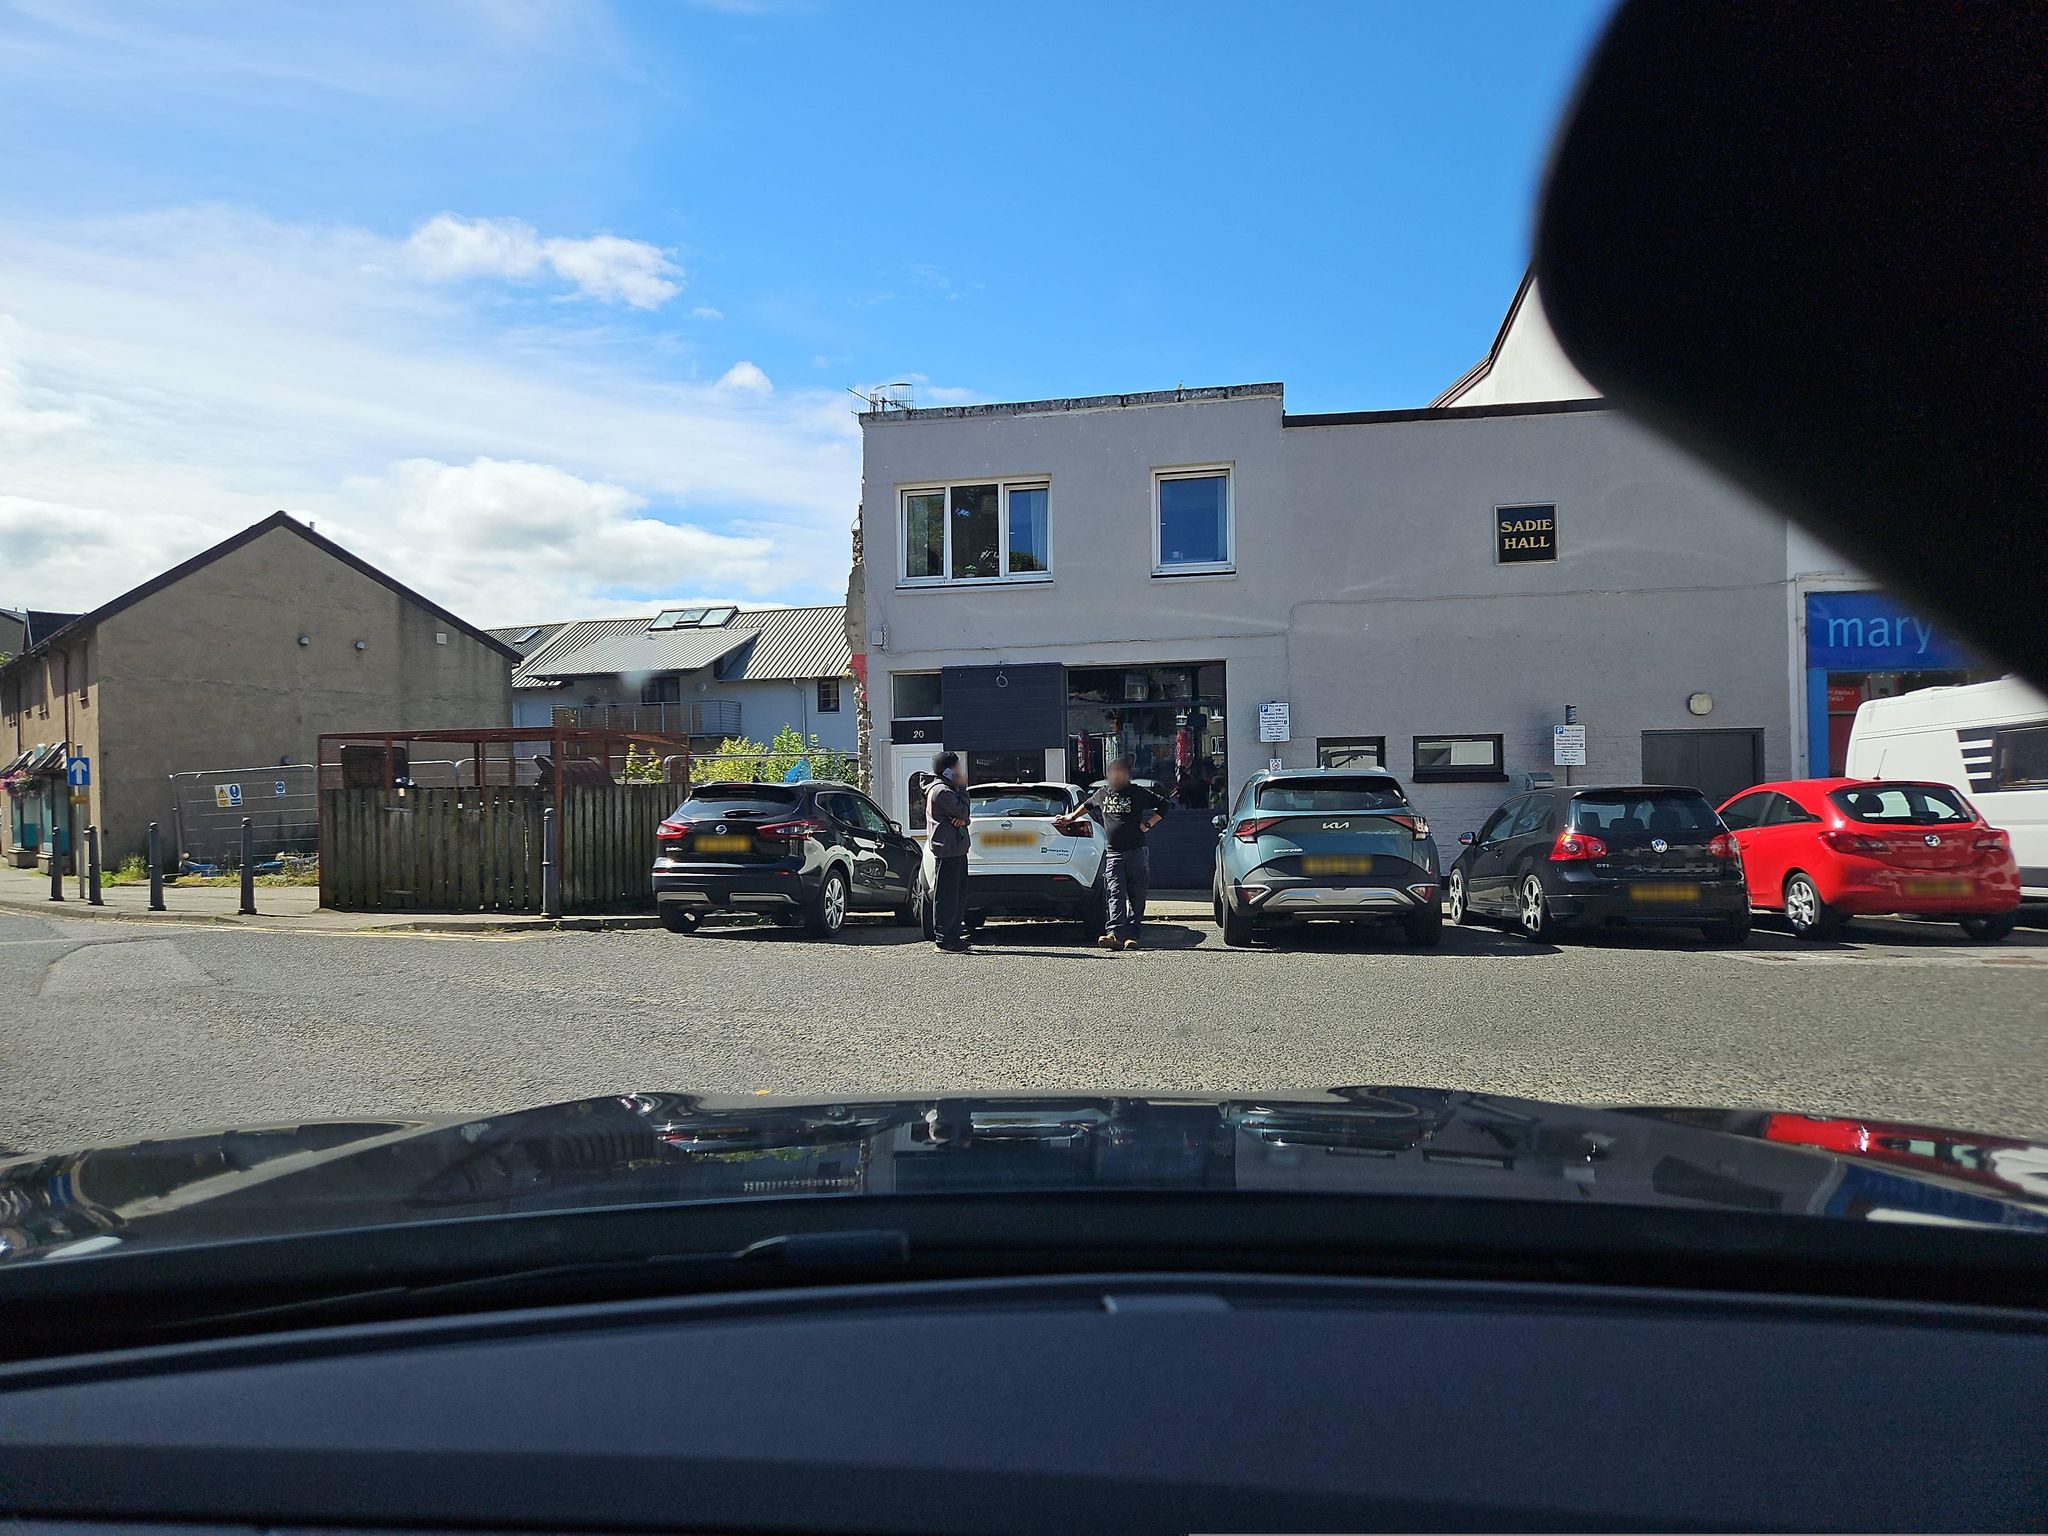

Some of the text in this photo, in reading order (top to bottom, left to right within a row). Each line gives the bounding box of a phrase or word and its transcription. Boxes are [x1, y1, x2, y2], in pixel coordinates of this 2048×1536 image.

[1500, 519, 1553, 532] SADIE
[1504, 536, 1550, 549] HALL
[1828, 616, 1932, 654] mary
[913, 730, 925, 739] 20
[1102, 805, 1131, 813] JONES
